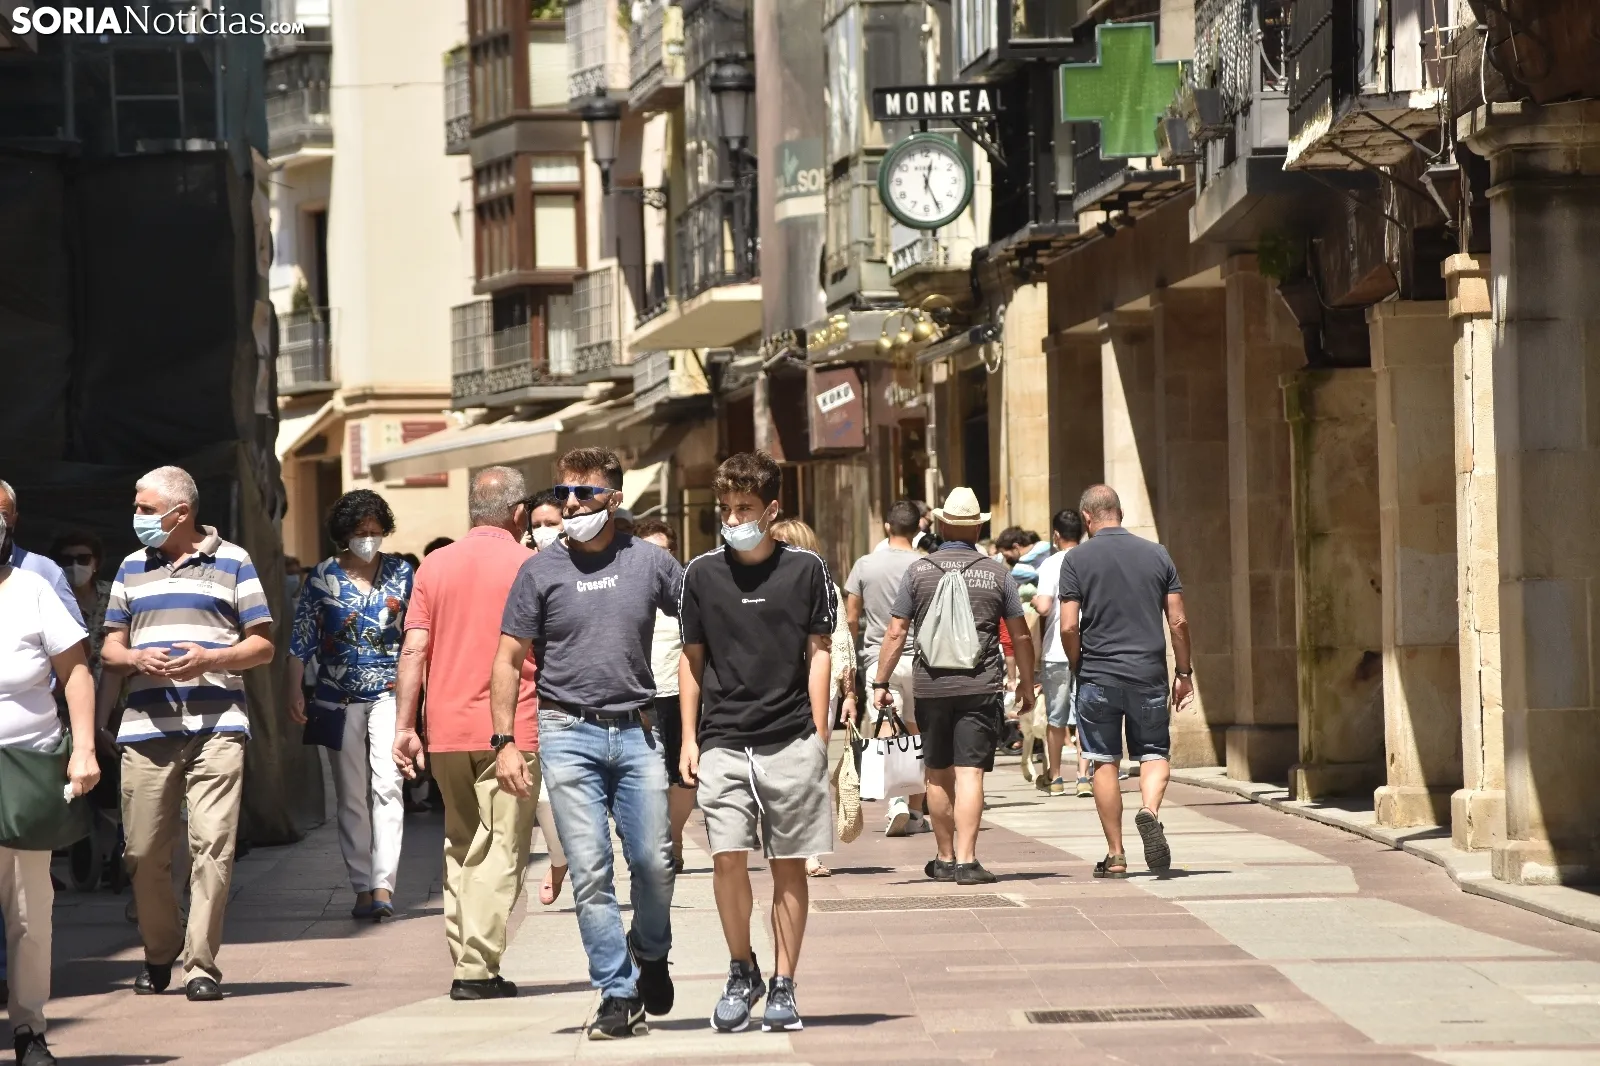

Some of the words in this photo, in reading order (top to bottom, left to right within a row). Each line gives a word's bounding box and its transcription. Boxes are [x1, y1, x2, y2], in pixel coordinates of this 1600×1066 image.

[885, 89, 1007, 115] MONREAL
[946, 163, 953, 172] 2
[895, 178, 903, 186] 9
[950, 177, 957, 185] 3
[899, 191, 907, 199] 8
[910, 200, 917, 208] 7
[923, 204, 930, 213] 6
[916, 563, 936, 572] WEST
[940, 561, 967, 569] COAST
[968, 578, 998, 590] CAMP
